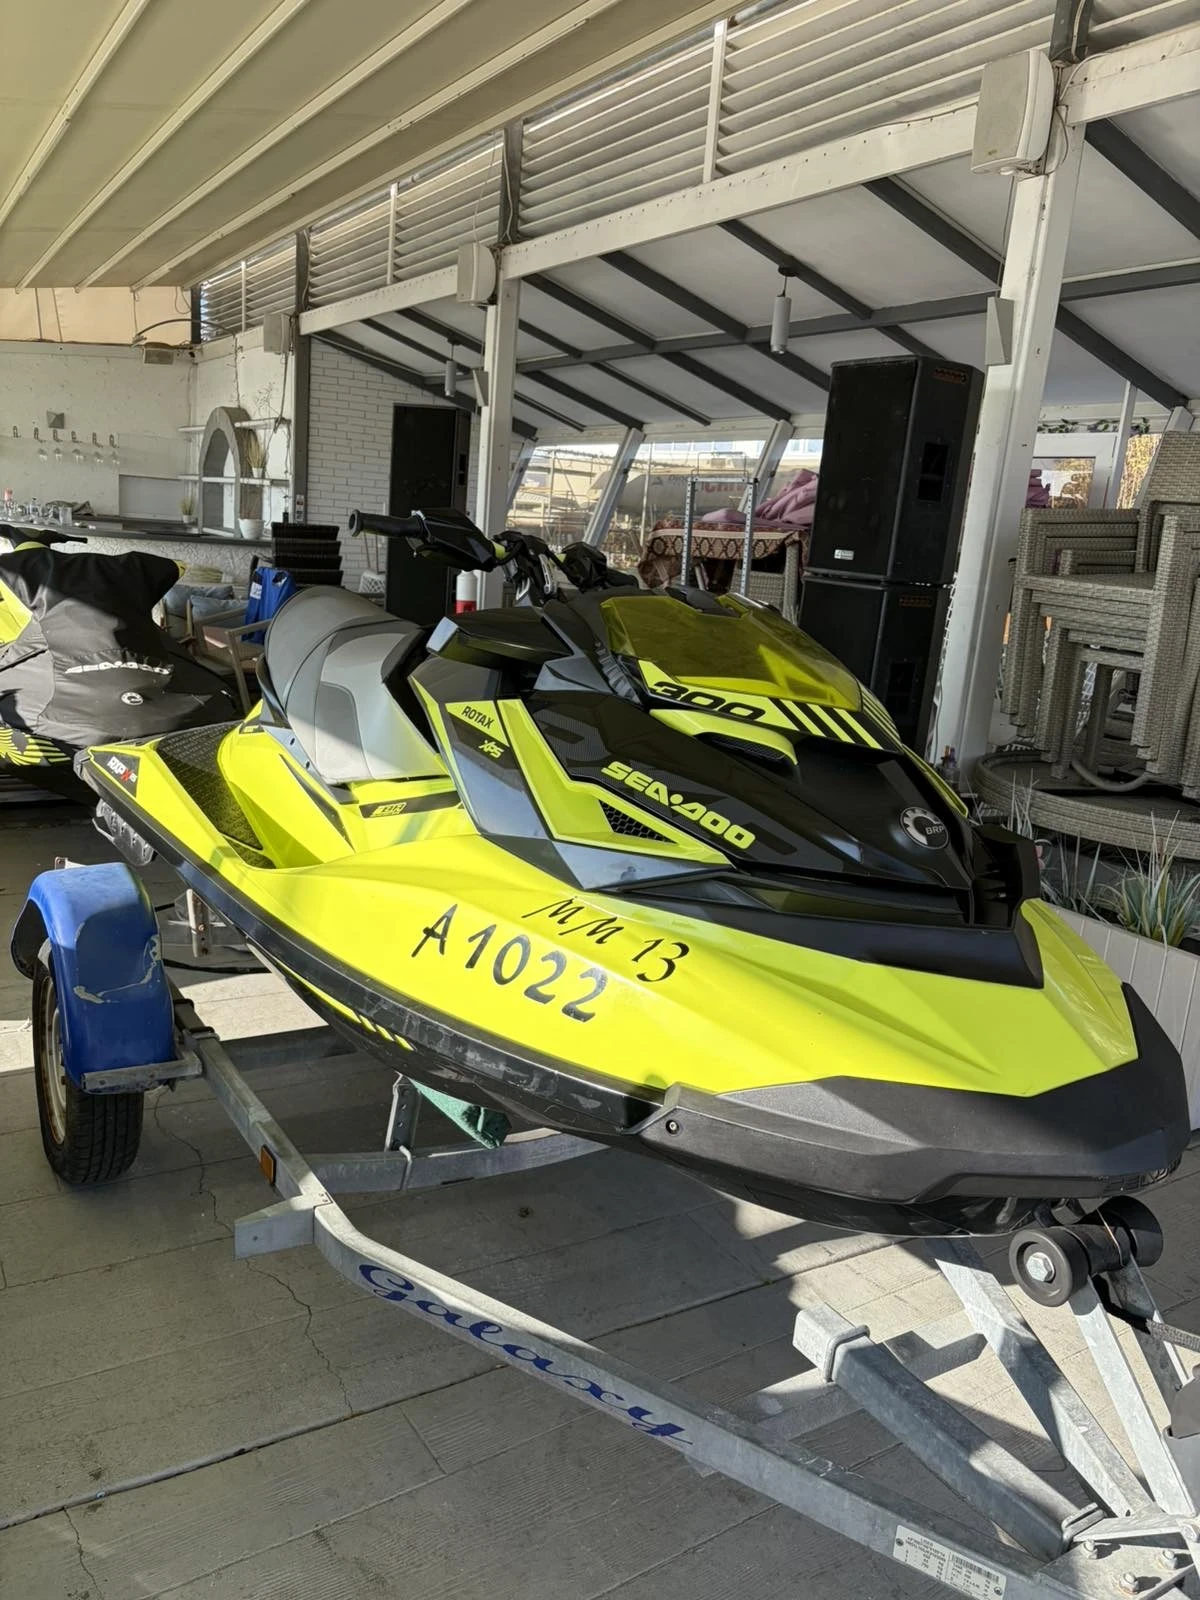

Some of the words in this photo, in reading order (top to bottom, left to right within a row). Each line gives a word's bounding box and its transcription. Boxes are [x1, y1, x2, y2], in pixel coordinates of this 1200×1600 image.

[461, 705, 494, 729] ROTAX
[649, 681, 766, 721] 300
[478, 739, 505, 759] XPS
[925, 825, 945, 835] BRP
[631, 938, 690, 983] 13
[358, 1263, 694, 1447] Galaxy
